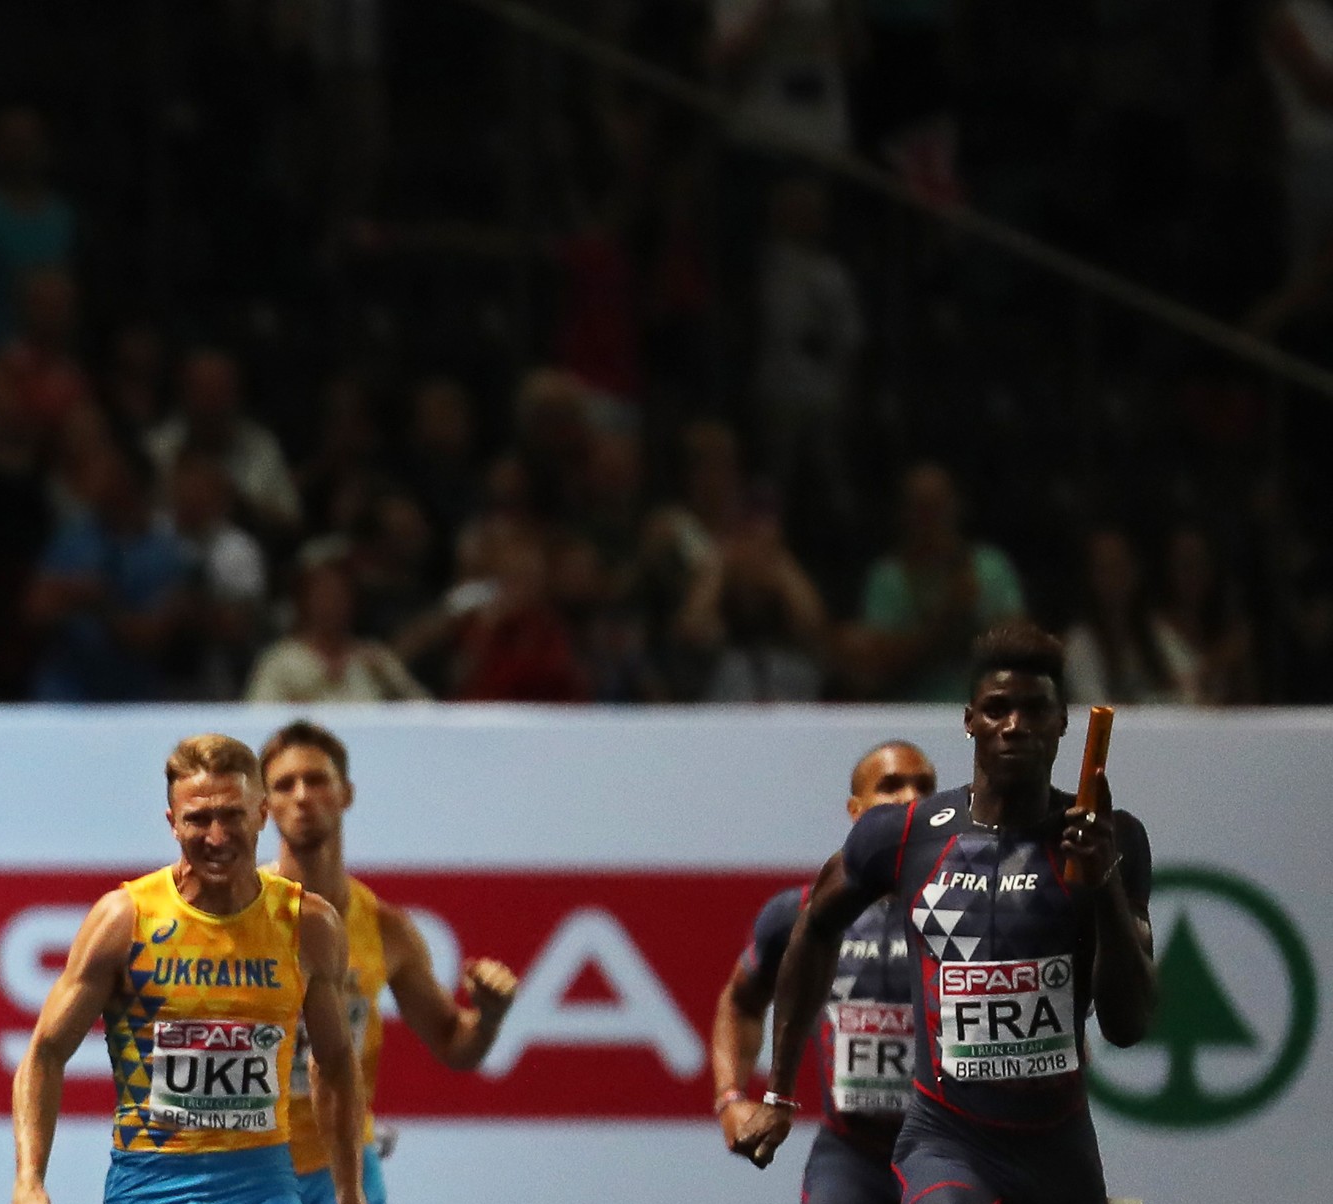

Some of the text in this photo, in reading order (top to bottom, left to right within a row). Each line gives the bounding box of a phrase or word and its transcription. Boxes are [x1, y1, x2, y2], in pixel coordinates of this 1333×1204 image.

[153, 957, 281, 988] UKRAINE
[944, 966, 1037, 992] SPAR
[955, 996, 1063, 1042] FRA
[159, 1025, 251, 1048] SPAR
[848, 1039, 915, 1075] FR
[956, 1055, 1067, 1079] BERLIN 2018
[166, 1055, 271, 1096] UKR
[163, 1109, 267, 1129] BERLIN 2018
